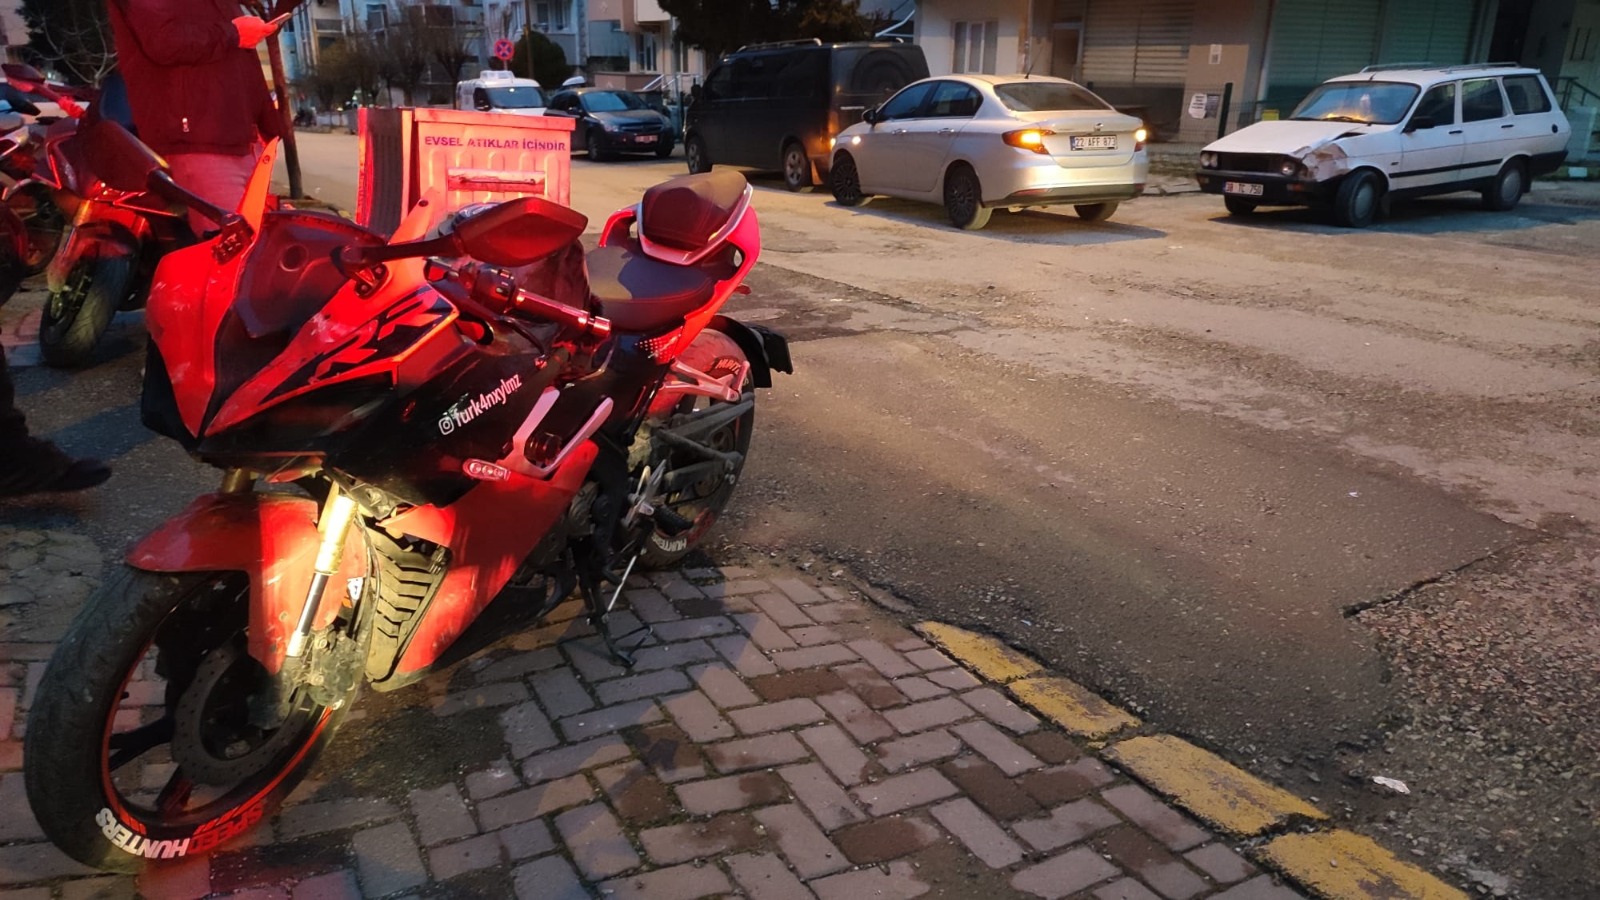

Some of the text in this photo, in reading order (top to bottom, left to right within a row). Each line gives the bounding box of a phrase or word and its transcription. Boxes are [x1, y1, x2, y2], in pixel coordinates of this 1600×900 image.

[424, 136, 464, 147] EVSEL
[467, 138, 520, 149] ATIKLAR
[1075, 137, 1085, 147] 22
[1088, 137, 1101, 147] AFF
[95, 807, 190, 859] HUNTERS
